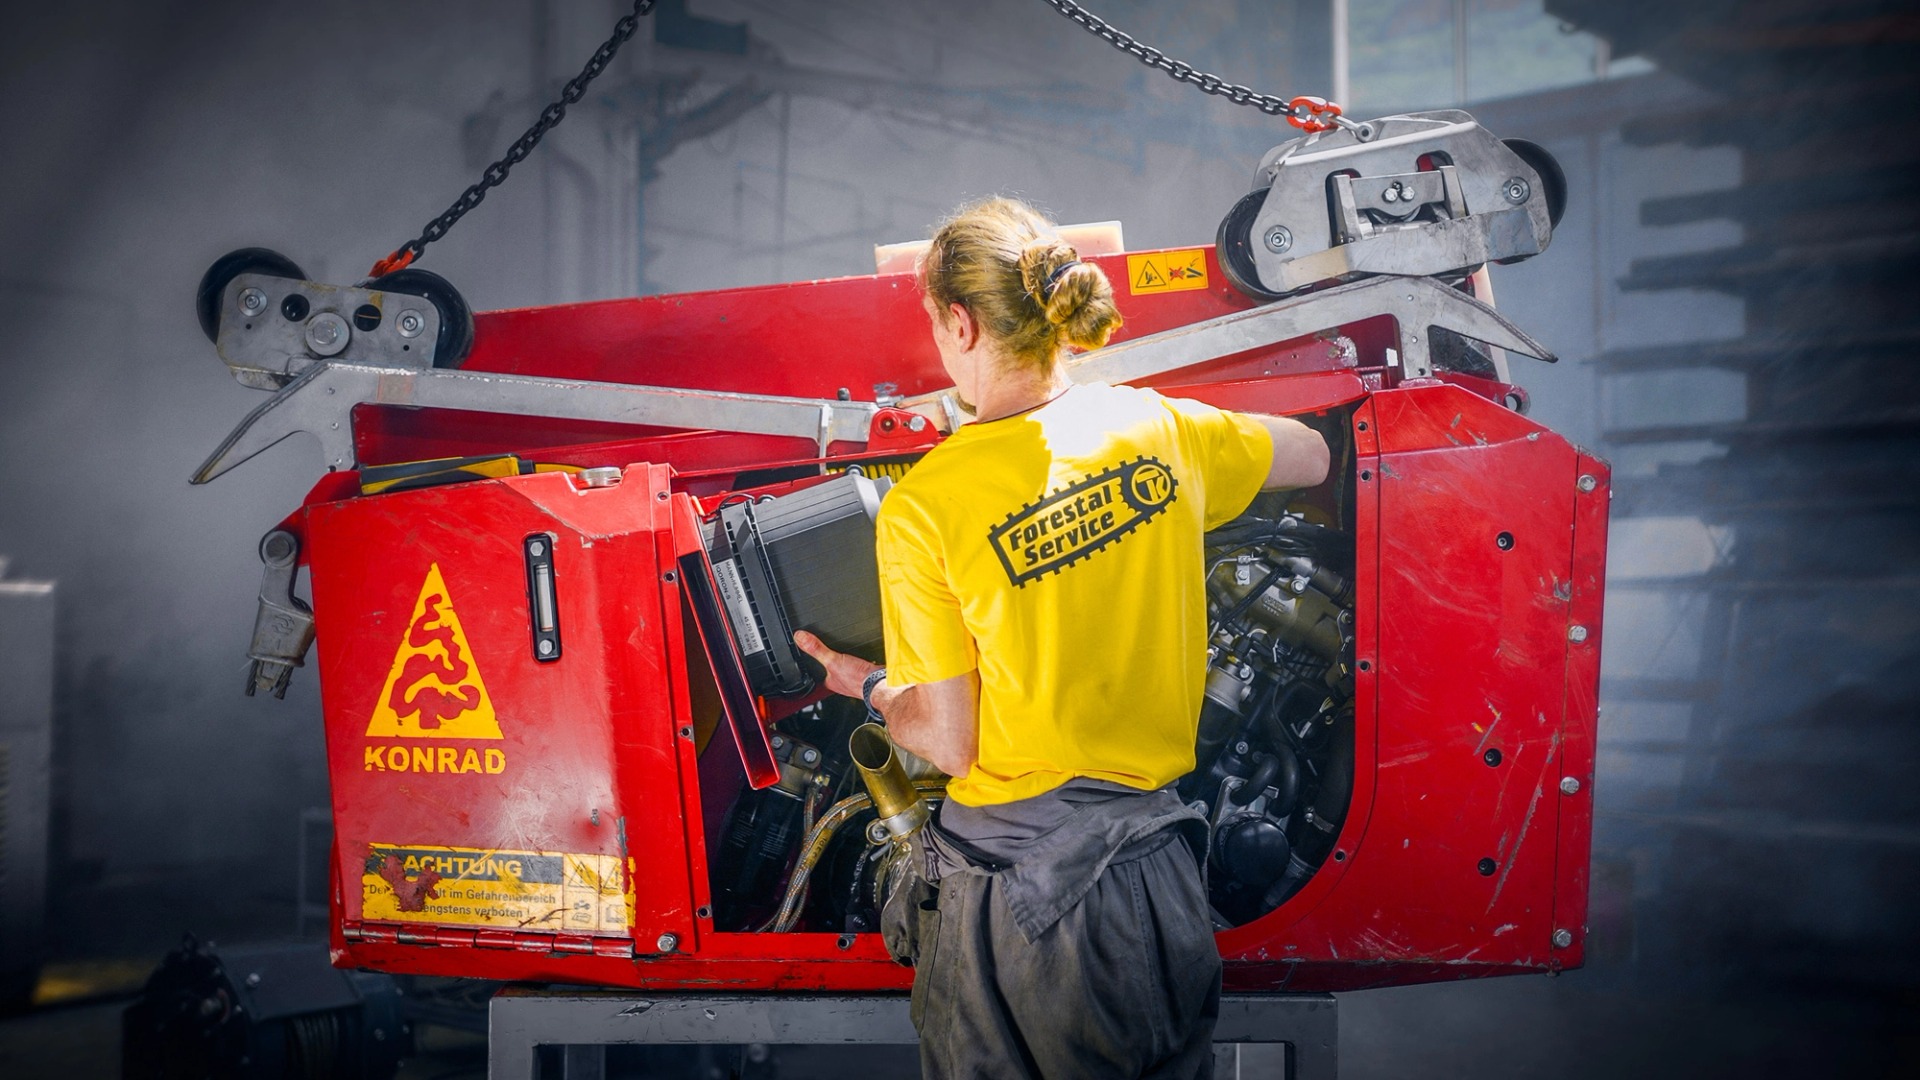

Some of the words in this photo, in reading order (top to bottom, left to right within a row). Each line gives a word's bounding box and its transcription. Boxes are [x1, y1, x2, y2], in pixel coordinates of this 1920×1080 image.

[1008, 483, 1113, 552] Forestal
[1024, 510, 1115, 567] Service
[364, 745, 506, 775] KONRAD
[403, 854, 523, 877] ACHTUNG
[449, 888, 463, 899] im
[474, 906, 523, 918] verboten
